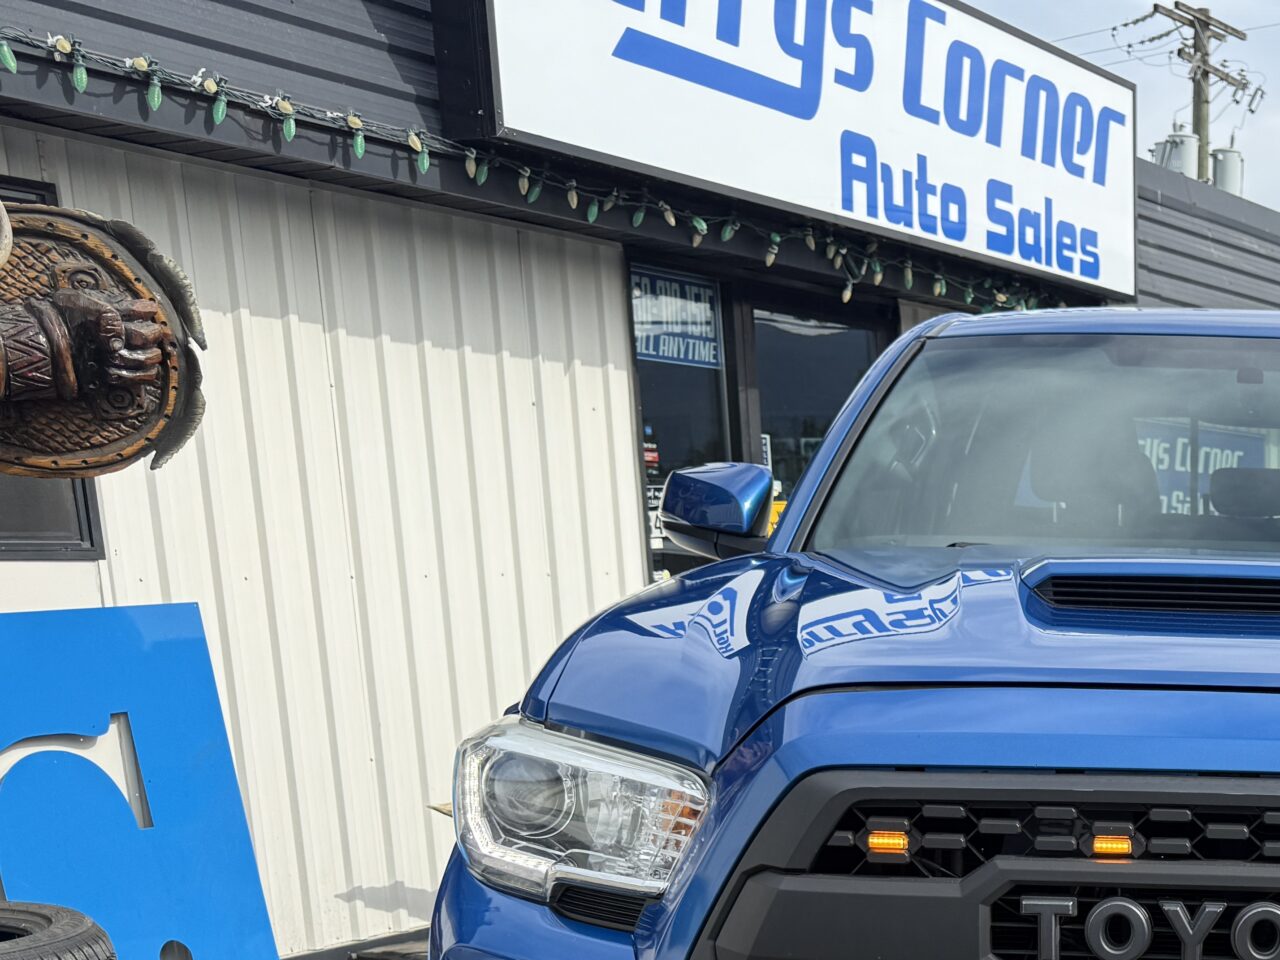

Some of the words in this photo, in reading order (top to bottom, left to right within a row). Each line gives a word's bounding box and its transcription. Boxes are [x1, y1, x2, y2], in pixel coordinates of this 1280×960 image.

[902, 0, 1126, 187] Corner
[840, 129, 967, 242] Auto
[986, 178, 1100, 280] Sales
[658, 335, 718, 363] ANYTIME
